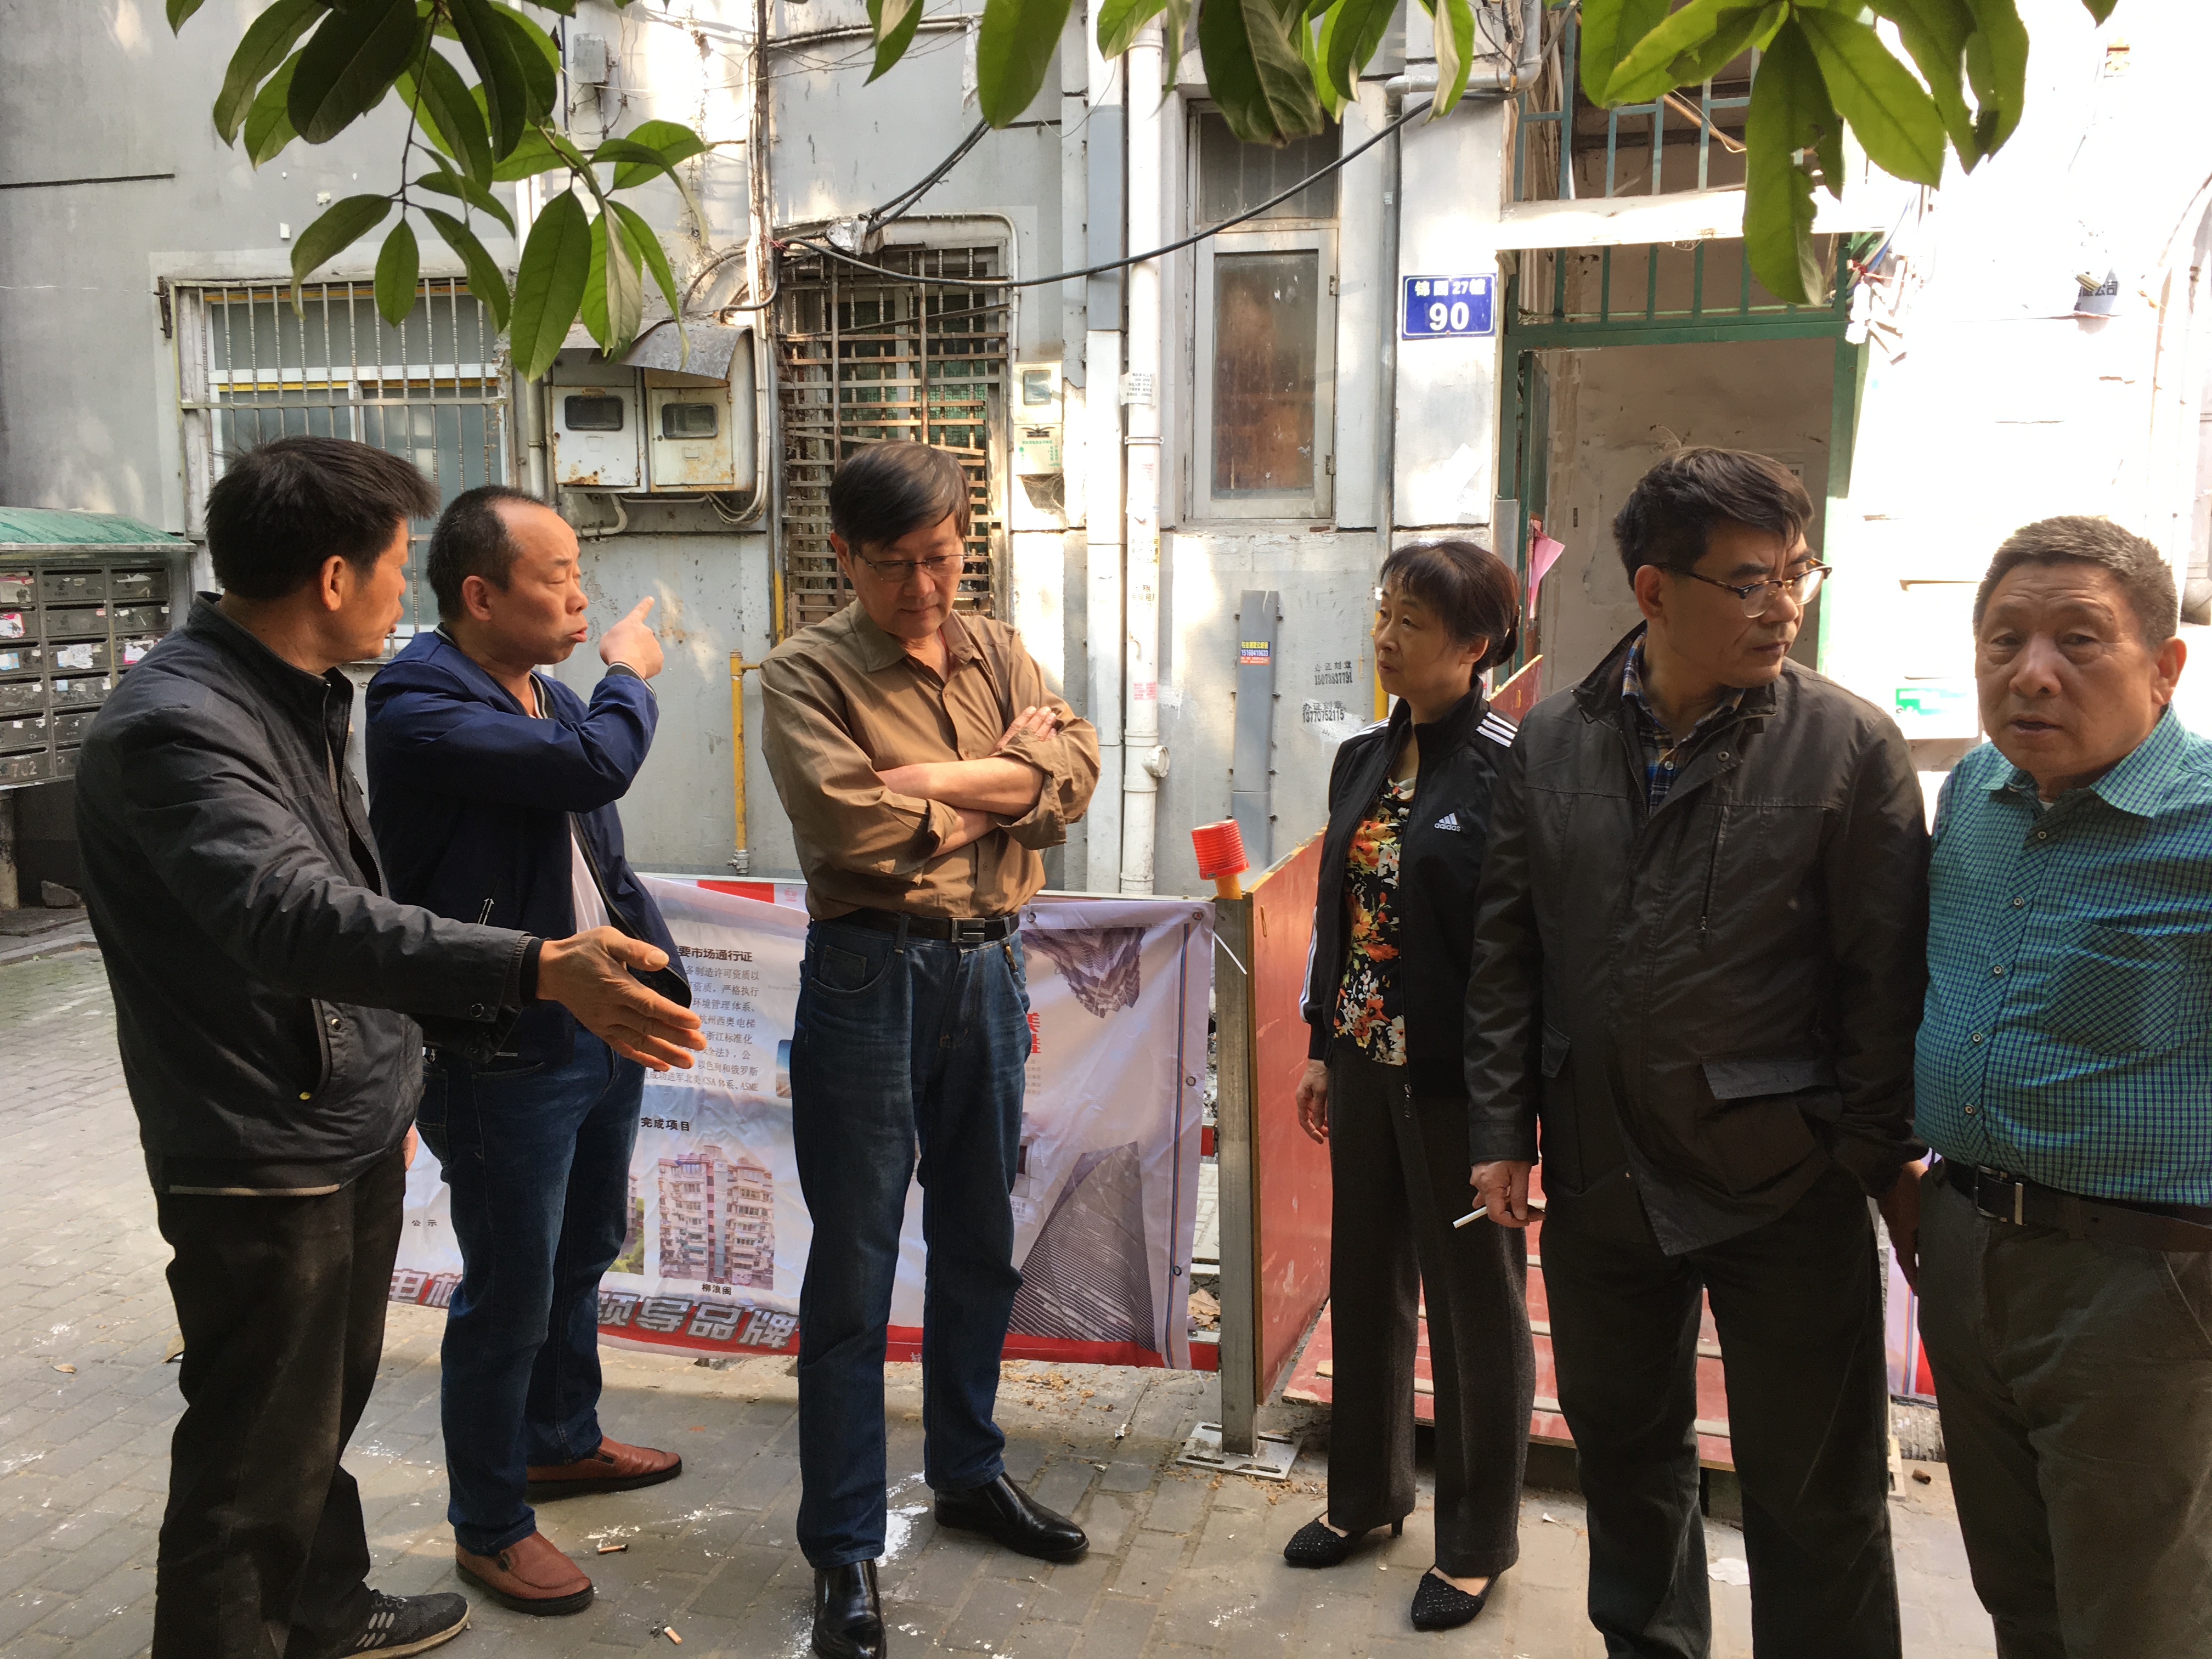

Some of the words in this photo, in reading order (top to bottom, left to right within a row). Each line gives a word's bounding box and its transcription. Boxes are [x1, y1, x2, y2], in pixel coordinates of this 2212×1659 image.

[1429, 302, 1469, 331] 90
[1302, 701, 1344, 712] 办证刻章
[1302, 709, 1344, 723] 13770752115
[1434, 823, 1460, 832] adidas
[675, 945, 753, 962] 要市场通行证
[699, 1014, 755, 1029] 杭州西奥电梯
[702, 1030, 753, 1045] 浙江标准化
[698, 1059, 758, 1076] 以色列和俄罗斯
[703, 1076, 716, 1086] CSA
[741, 1082, 759, 1092] ASME
[641, 1117, 690, 1132] 完成项目
[598, 1290, 798, 1349] 领导品牌
